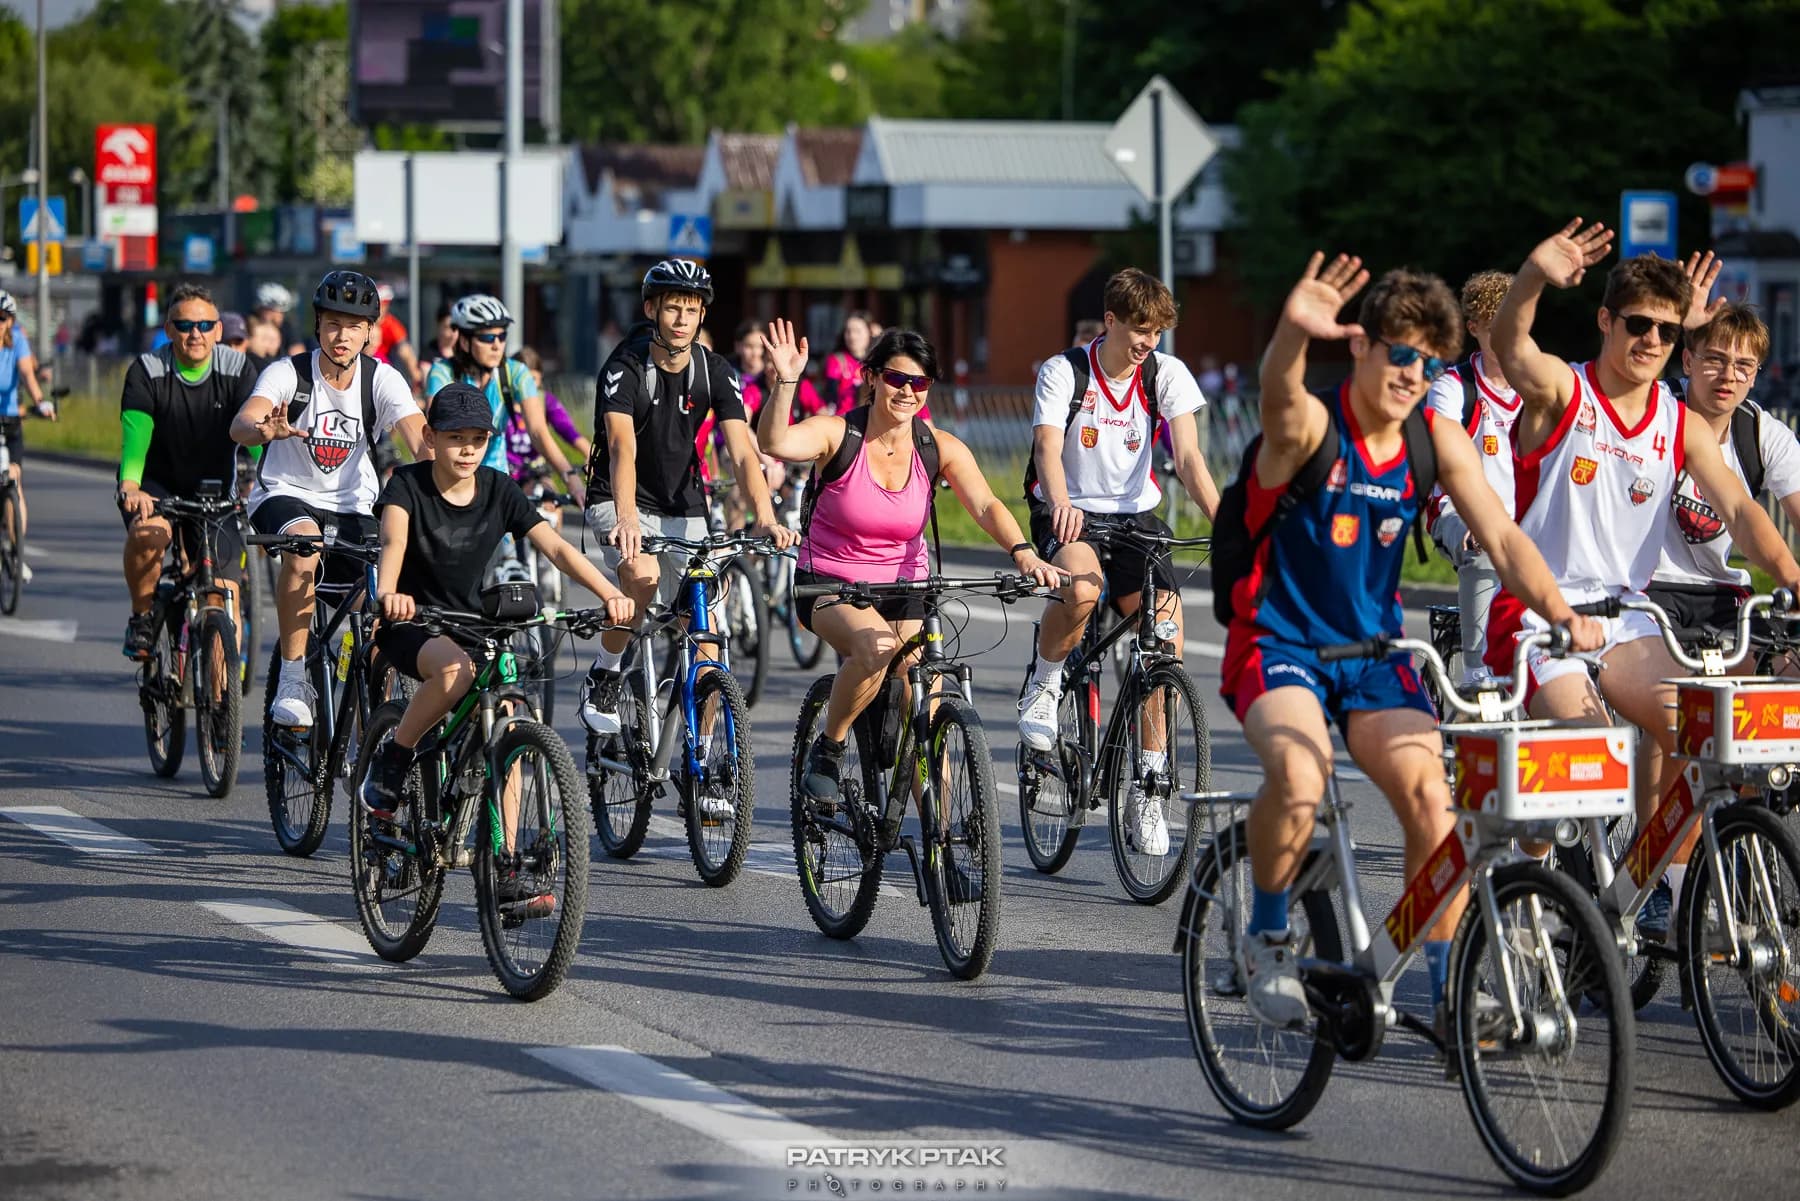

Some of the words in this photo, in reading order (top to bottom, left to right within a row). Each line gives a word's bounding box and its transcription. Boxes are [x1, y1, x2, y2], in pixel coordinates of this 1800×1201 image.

[1596, 442, 1644, 465] GIVOVA
[1652, 430, 1666, 461] 4
[1572, 467, 1591, 485] CK
